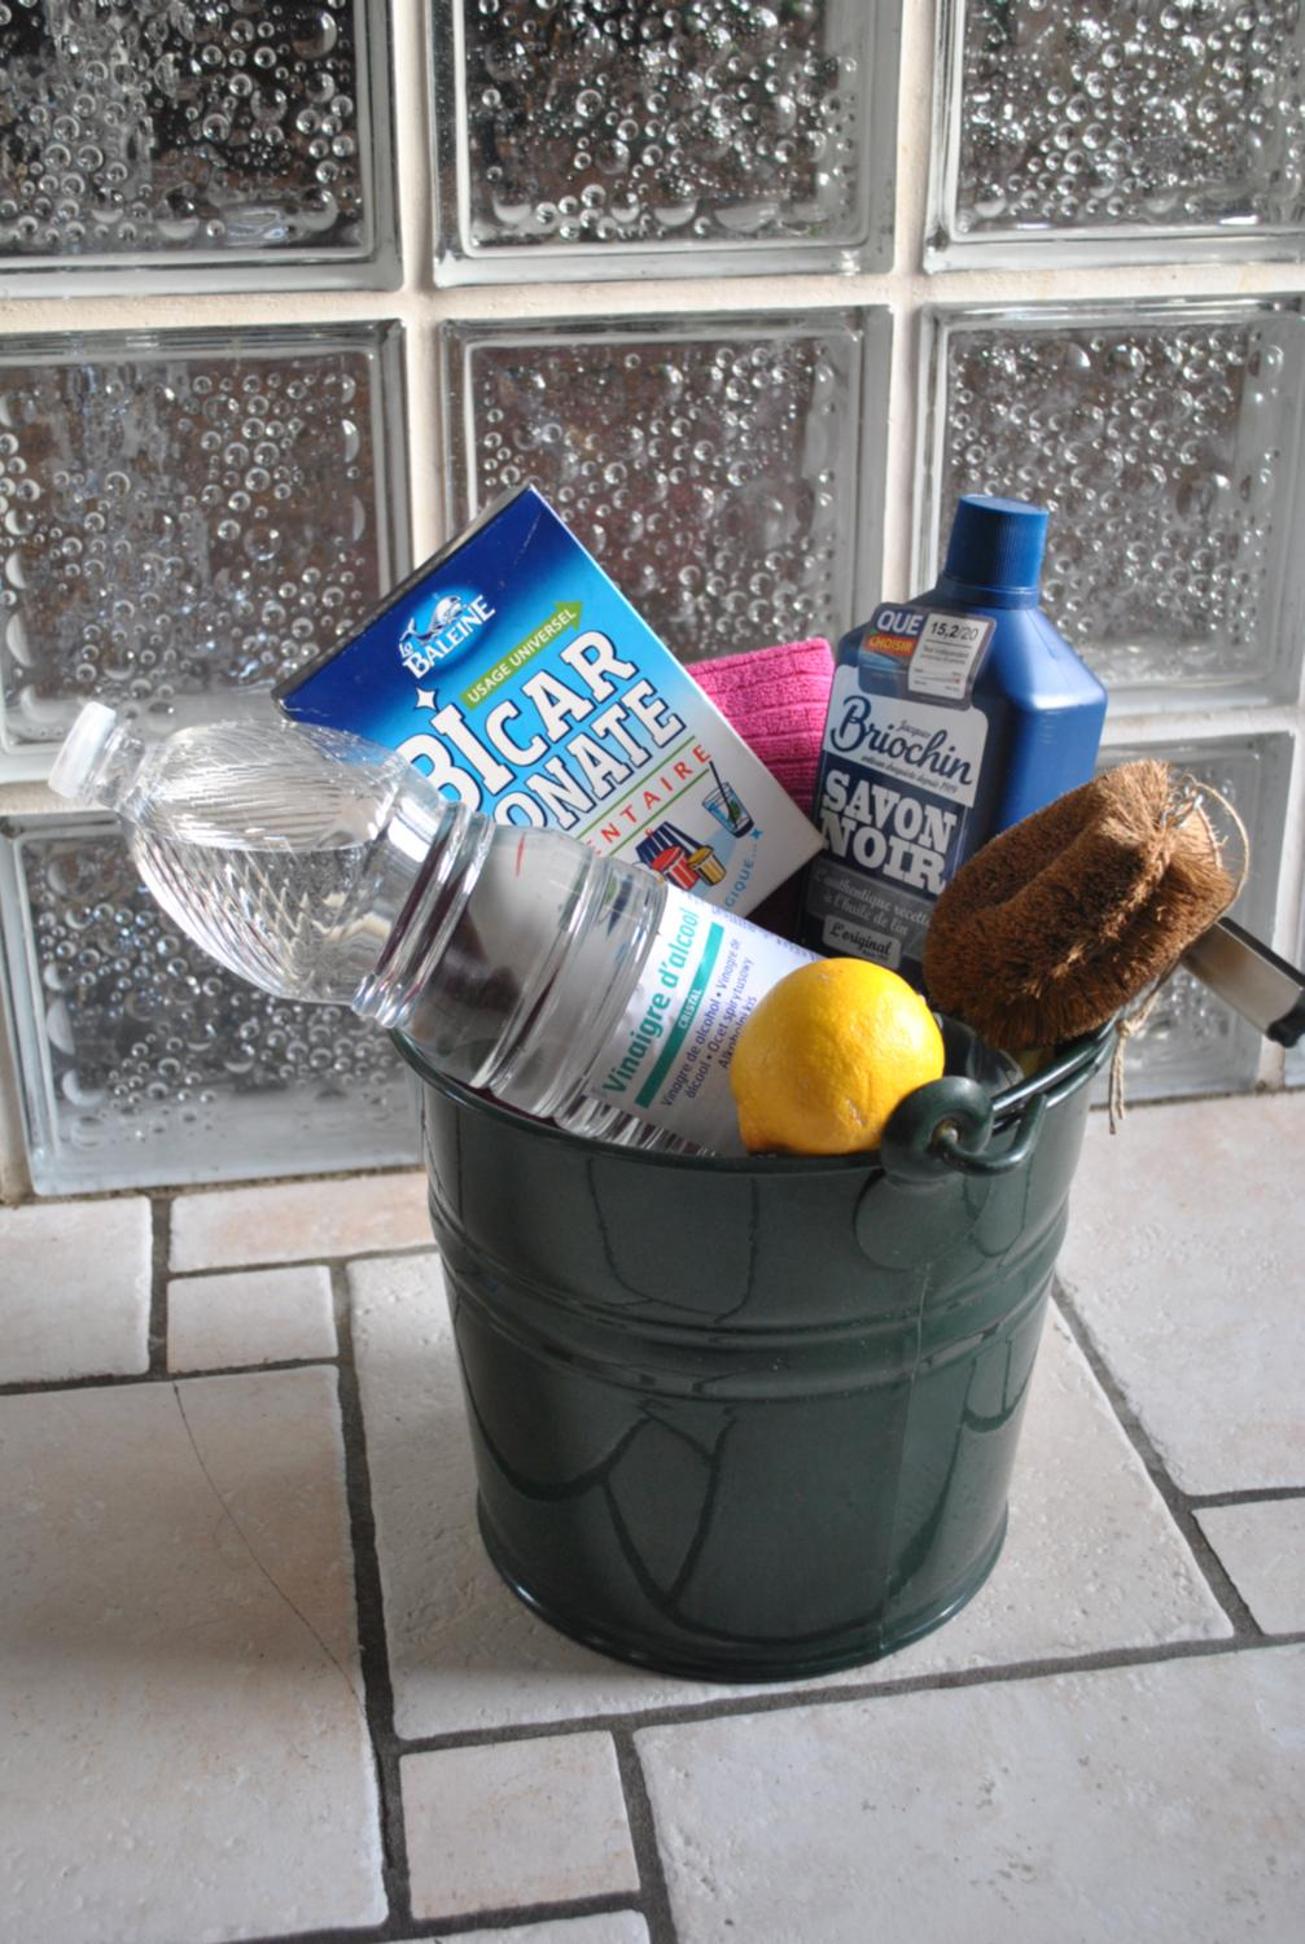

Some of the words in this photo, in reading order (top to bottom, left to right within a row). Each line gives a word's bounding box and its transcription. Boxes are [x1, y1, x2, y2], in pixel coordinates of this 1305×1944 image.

[403, 594, 496, 679] BALEINE
[467, 663, 512, 704] USAGE
[509, 609, 578, 667] UNIVERSEL
[877, 610, 925, 635] QUE
[931, 621, 979, 640] 15,2/20
[394, 630, 639, 812] BICAR
[493, 679, 687, 831] ONATE
[830, 695, 972, 785] Briochin
[586, 744, 711, 858] NTAIRE
[822, 770, 957, 854] SAVON
[820, 808, 947, 895] NOIR
[829, 921, 893, 956] L'original
[872, 914, 887, 928] de
[603, 992, 671, 1094] Vinaigre
[657, 906, 699, 988] d'alcool
[660, 1062, 694, 1107] Vinagre
[687, 1045, 701, 1063] de
[695, 998, 721, 1045] alcohol
[715, 949, 740, 990] Vinagre
[678, 988, 703, 1031] CRISTAL
[707, 1023, 729, 1053] Ocet
